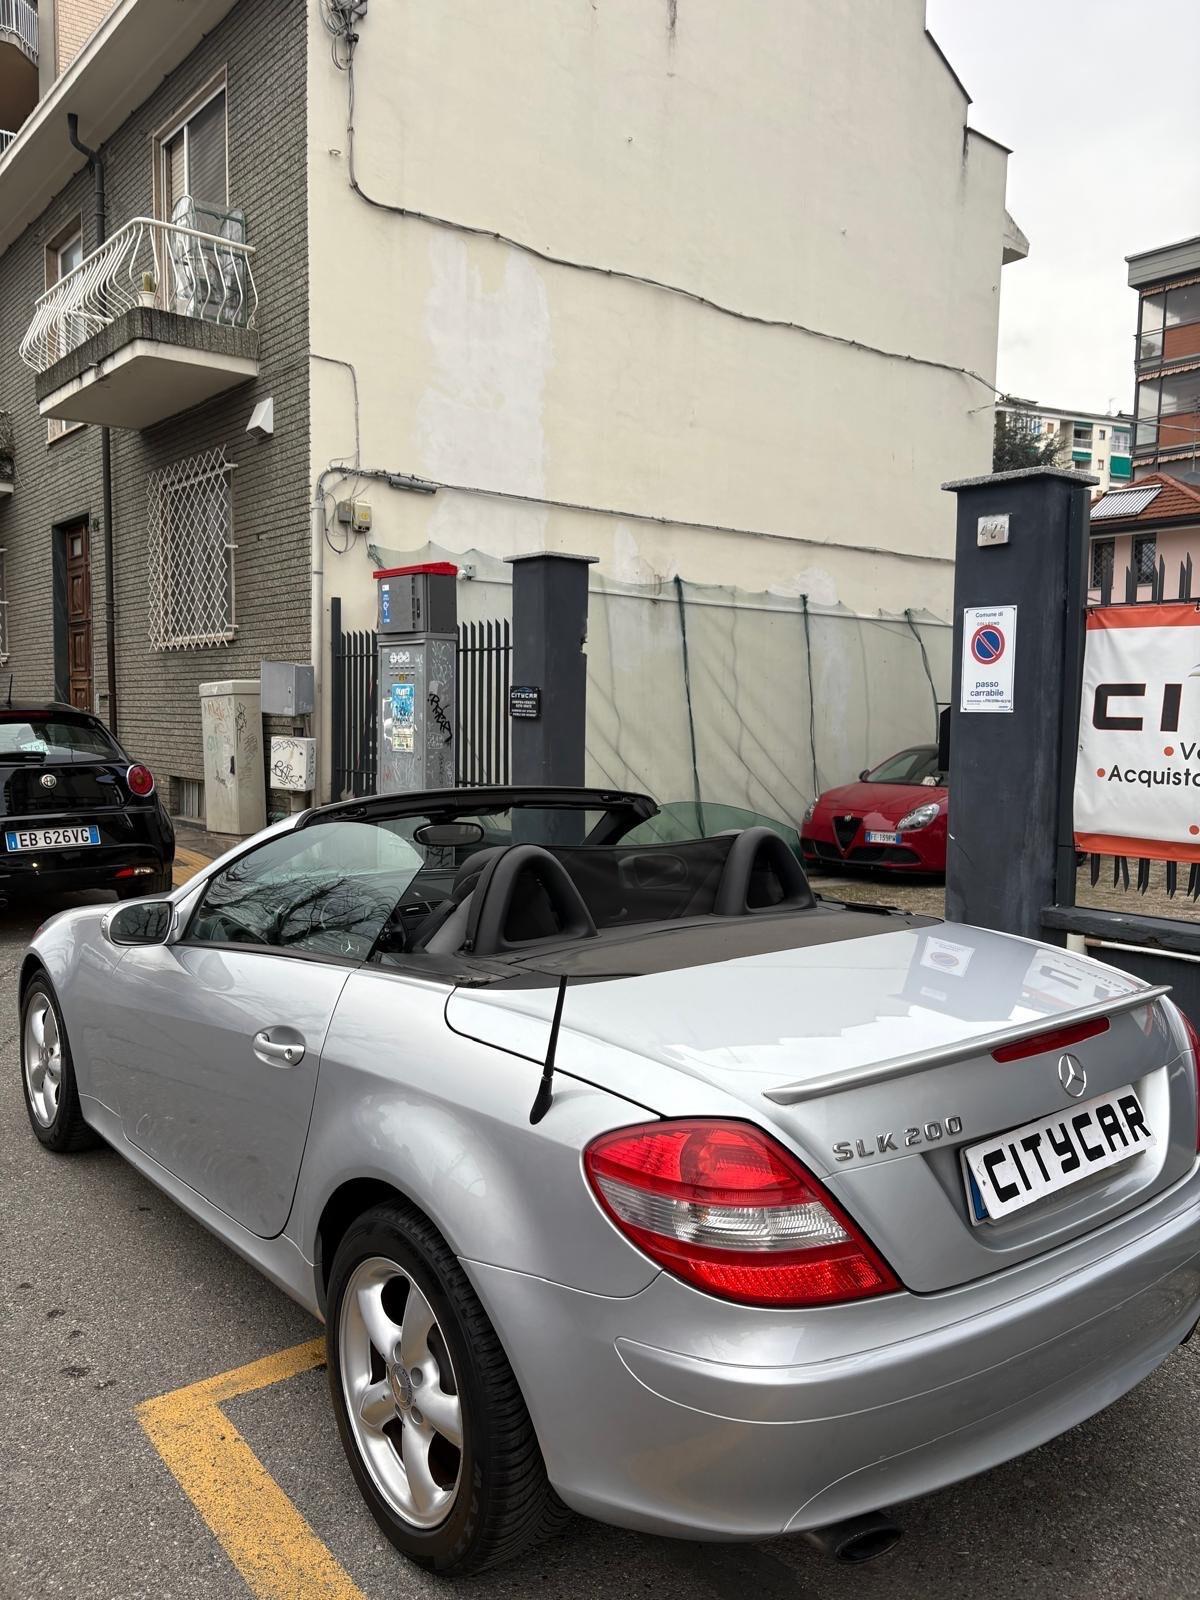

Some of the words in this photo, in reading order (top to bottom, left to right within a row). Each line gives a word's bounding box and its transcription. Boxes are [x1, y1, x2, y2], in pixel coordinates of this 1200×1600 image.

[975, 681, 999, 689] passo
[1180, 742, 1200, 760] V
[832, 1134, 899, 1162] SLK
[903, 1115, 964, 1148] 200
[982, 1095, 1152, 1203] CITYCAR
